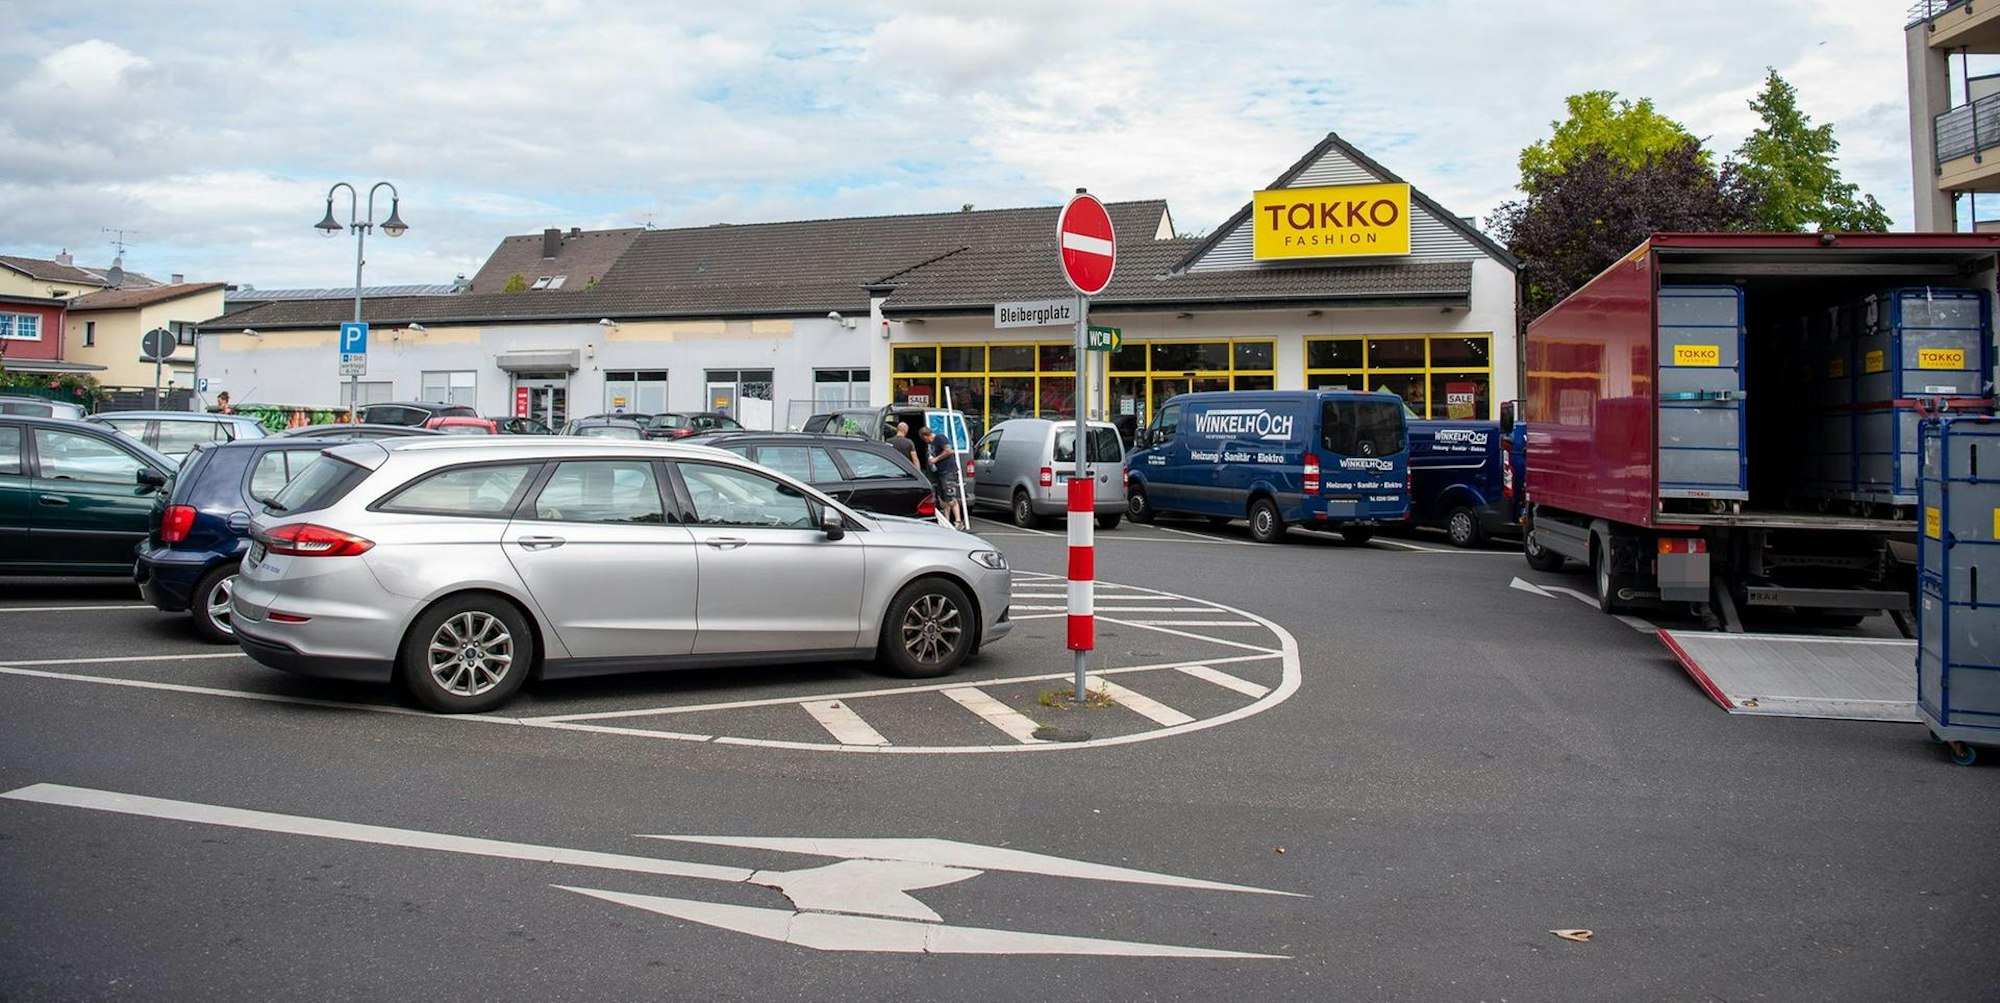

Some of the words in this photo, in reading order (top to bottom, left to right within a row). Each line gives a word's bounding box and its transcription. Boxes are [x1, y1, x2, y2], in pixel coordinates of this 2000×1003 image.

[1285, 233, 1377, 246] FASHION
[1000, 305, 1070, 324] Bleibergplatz
[346, 327, 361, 350] P
[1089, 331, 1103, 346] WC
[200, 379, 207, 391] P
[910, 395, 928, 404] SALE
[1449, 395, 1473, 403] SALE
[1195, 410, 1293, 438] WINKELHOCH
[1434, 430, 1488, 443] WINKELHOCH
[1191, 451, 1219, 463] Heizung
[1224, 452, 1251, 463] Sanitär
[1257, 453, 1284, 463] Elektro
[1339, 458, 1393, 470] WINKELHOCH
[1326, 482, 1352, 490] Heizung
[1357, 481, 1380, 489] Sanitär
[1384, 481, 1403, 489] Elektro
